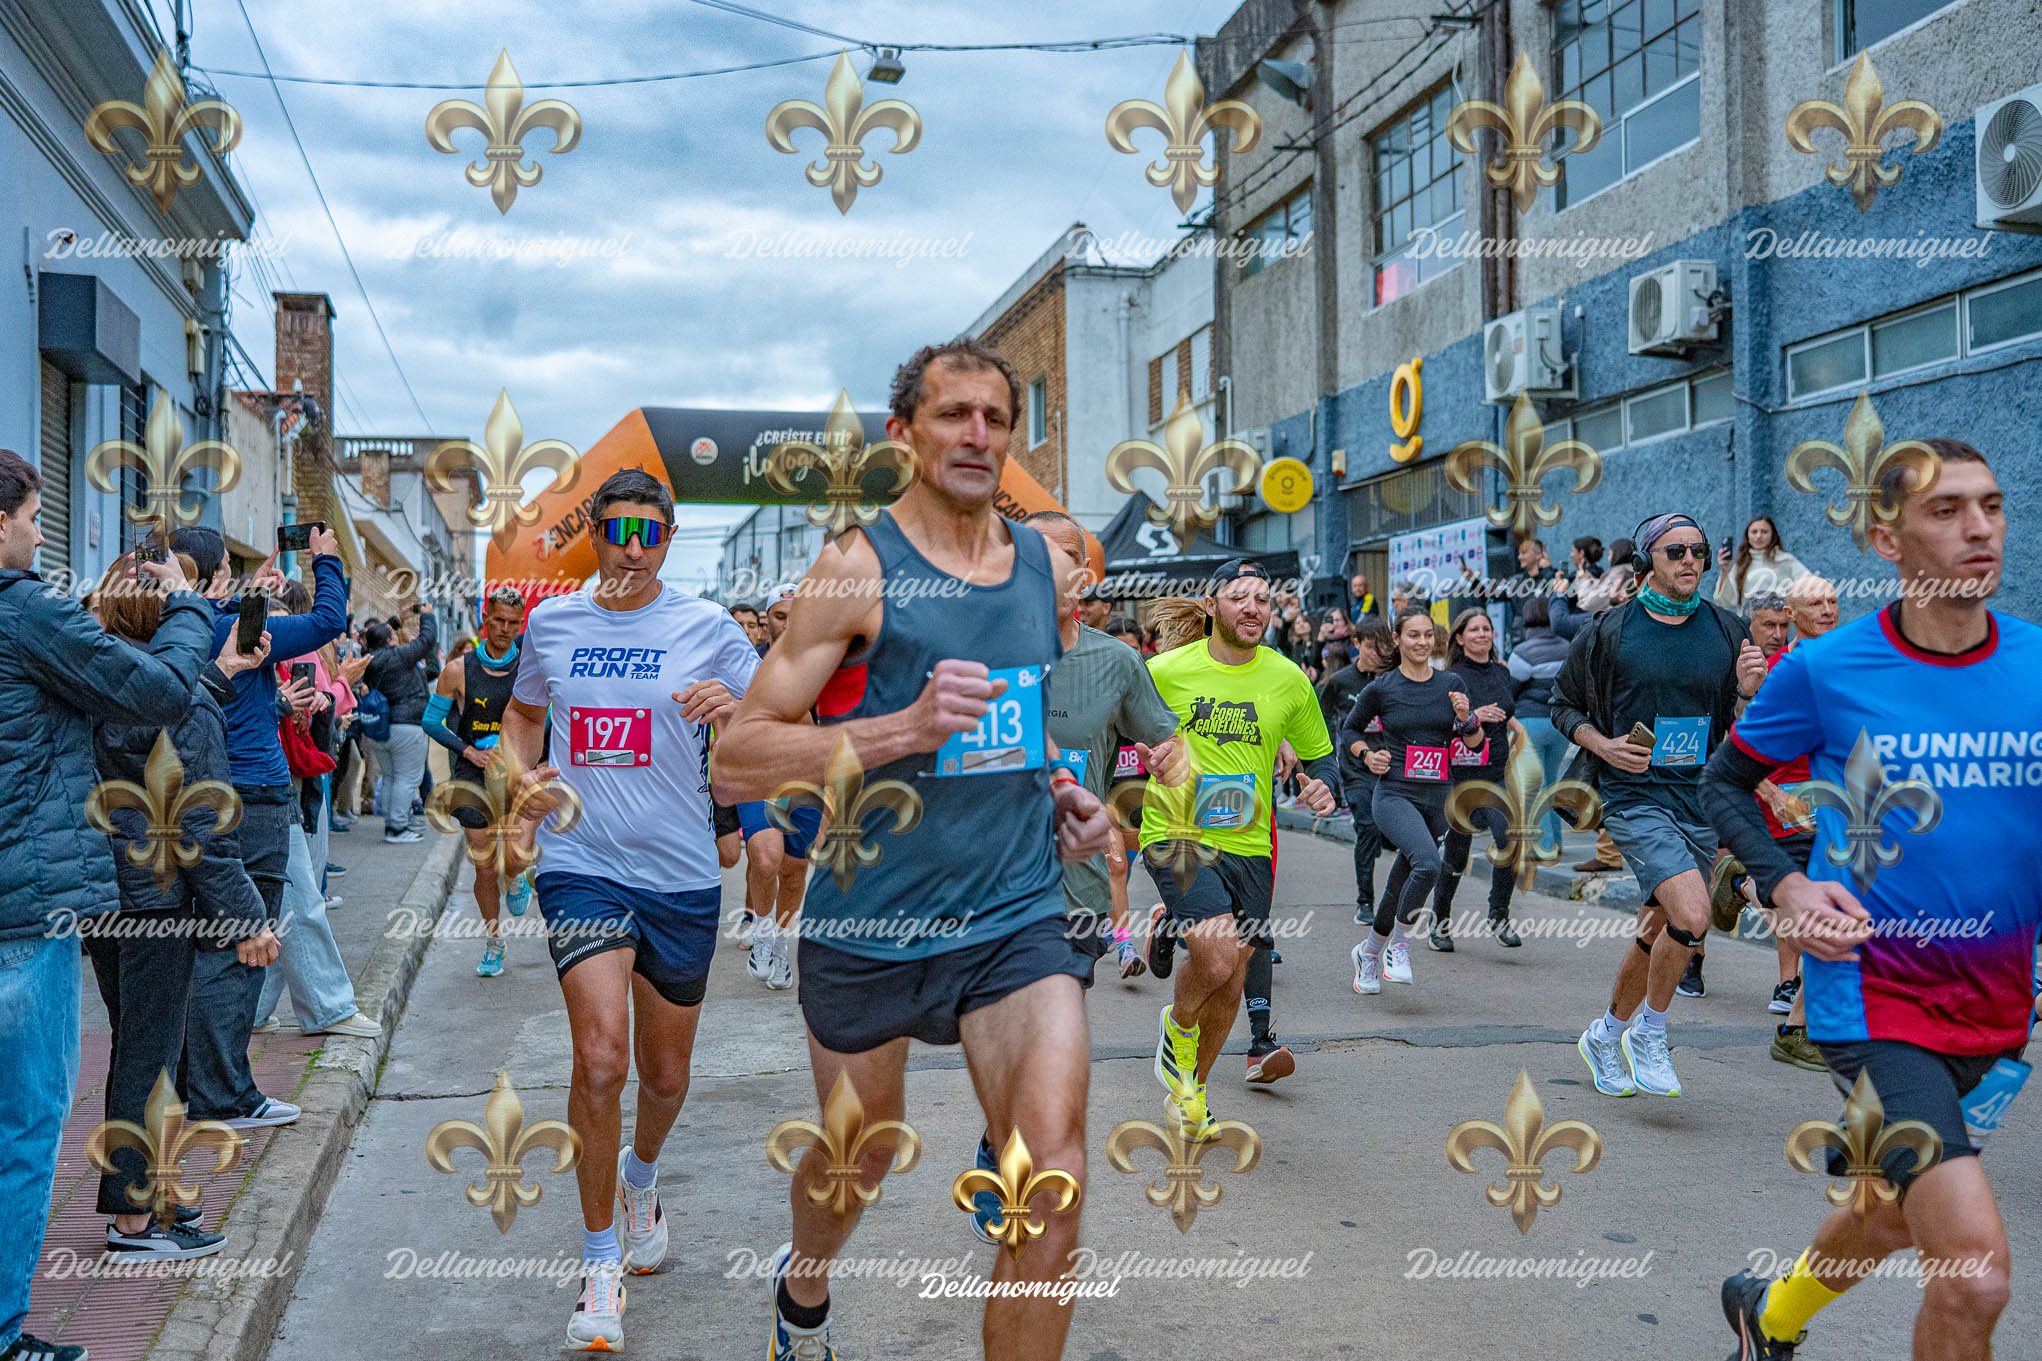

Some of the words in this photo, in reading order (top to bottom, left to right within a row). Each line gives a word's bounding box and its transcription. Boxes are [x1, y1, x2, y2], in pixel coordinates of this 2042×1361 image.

[570, 647, 667, 663] PROFIT
[569, 662, 628, 678] RUN
[630, 672, 659, 680] TEAM
[961, 699, 1023, 747] 413
[1210, 707, 1247, 721] CORRE
[584, 716, 633, 748] 197
[1194, 718, 1257, 736] CANELONES
[1662, 731, 1700, 754] 424
[1413, 751, 1443, 770] 247
[1207, 789, 1244, 814] 410
